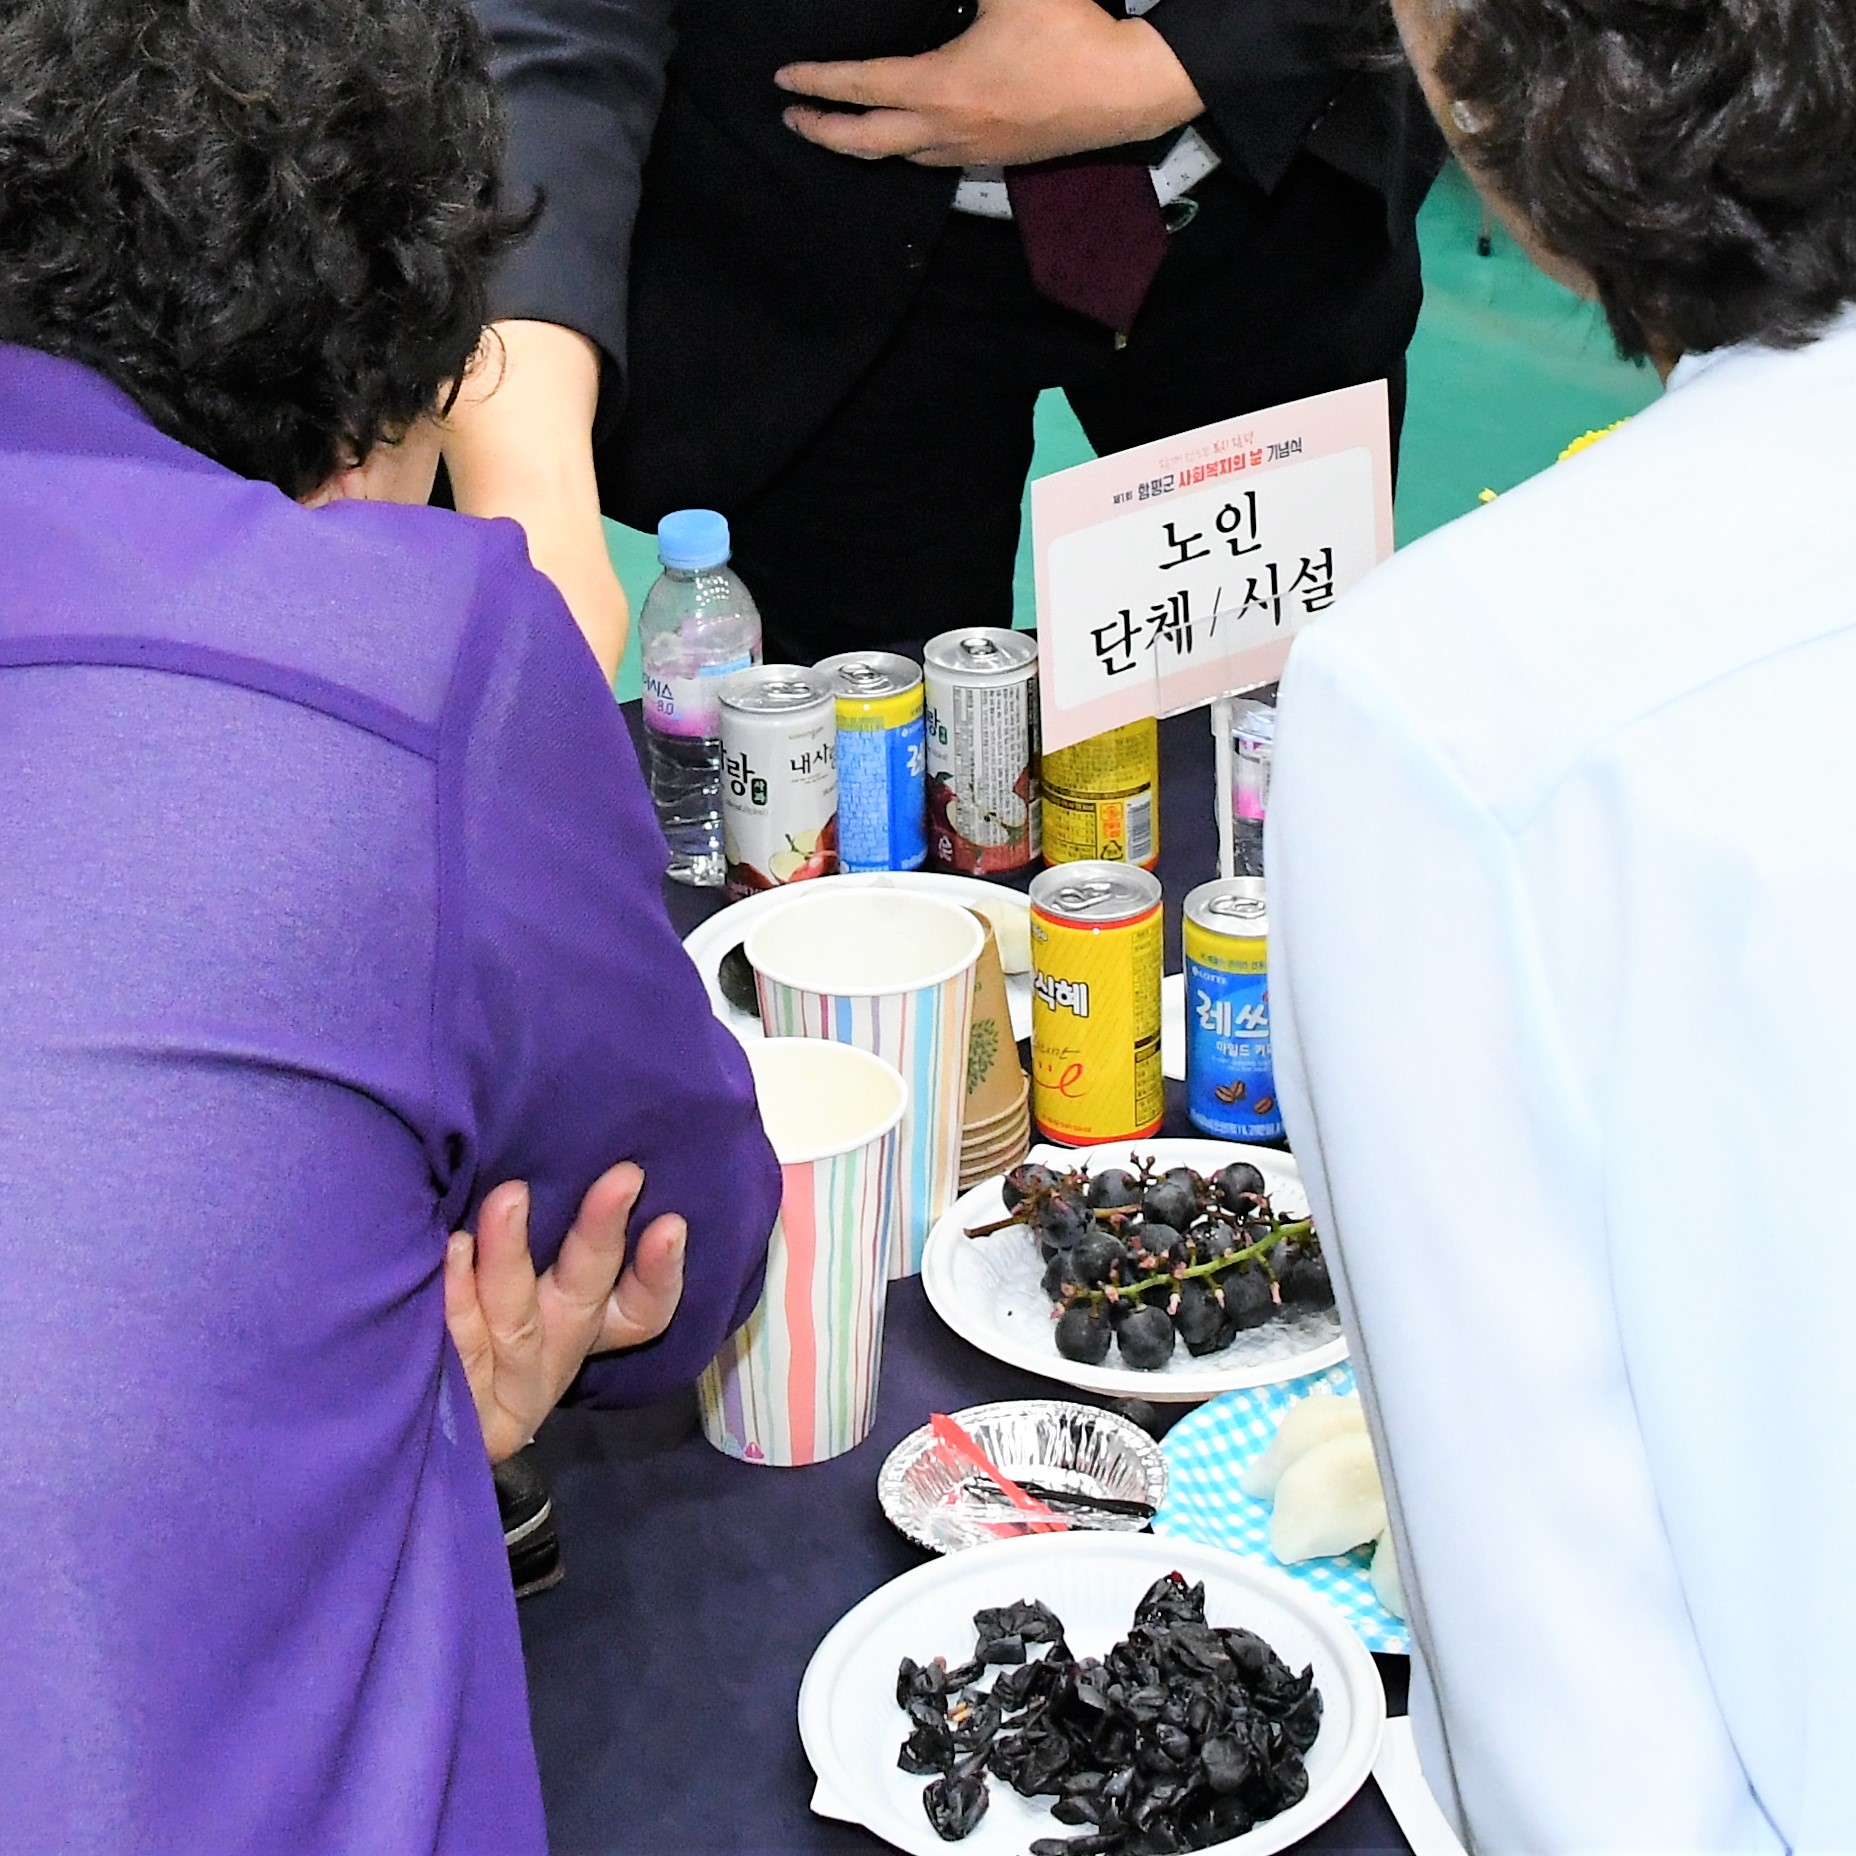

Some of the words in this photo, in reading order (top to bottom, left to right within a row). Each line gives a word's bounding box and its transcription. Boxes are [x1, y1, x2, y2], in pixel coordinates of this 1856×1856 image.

[1137, 474, 1176, 501] 함평군
[1178, 453, 1246, 489] 사회복지의
[1267, 436, 1303, 463] 기념식
[1158, 490, 1262, 571] 노인
